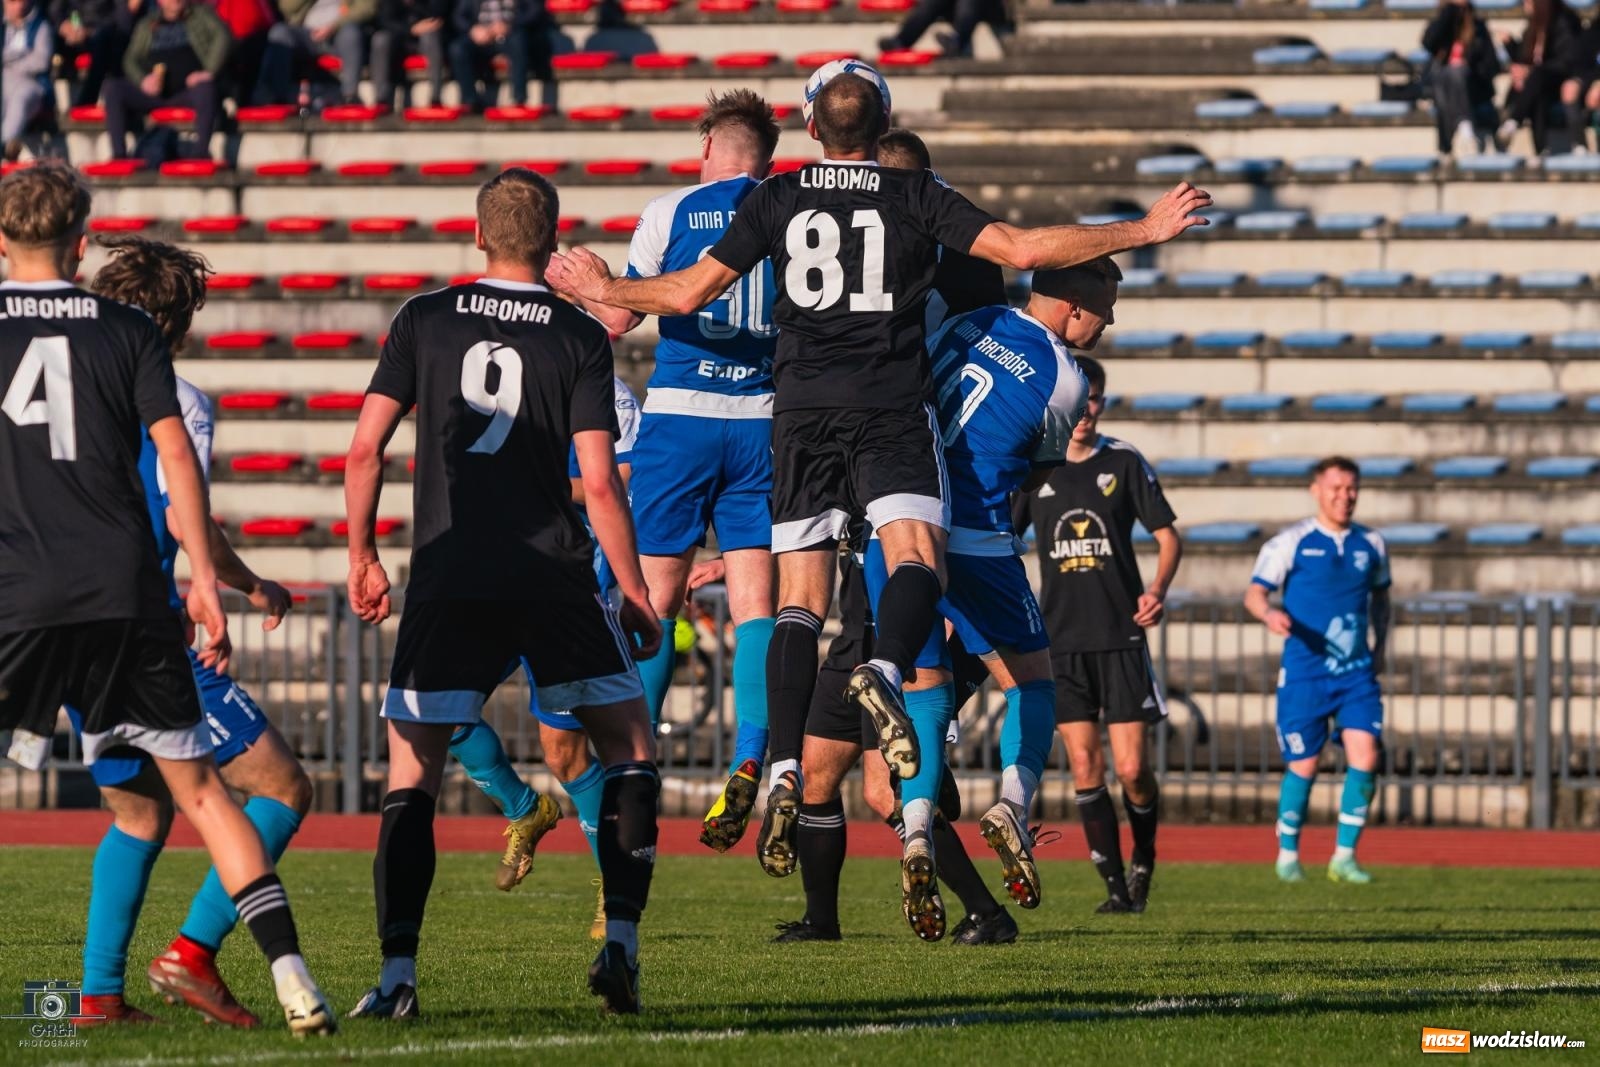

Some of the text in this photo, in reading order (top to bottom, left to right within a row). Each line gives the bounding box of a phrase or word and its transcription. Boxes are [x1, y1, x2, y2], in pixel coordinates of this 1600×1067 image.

[800, 167, 880, 192] LUBOMIA
[688, 210, 724, 230] UNIA
[785, 209, 894, 312] 81
[455, 294, 552, 325] LUBOMIA
[974, 335, 1037, 383] RACIBÓRZ
[0, 335, 77, 461] 4
[460, 340, 523, 454] 9
[1049, 537, 1113, 560] JANETA
